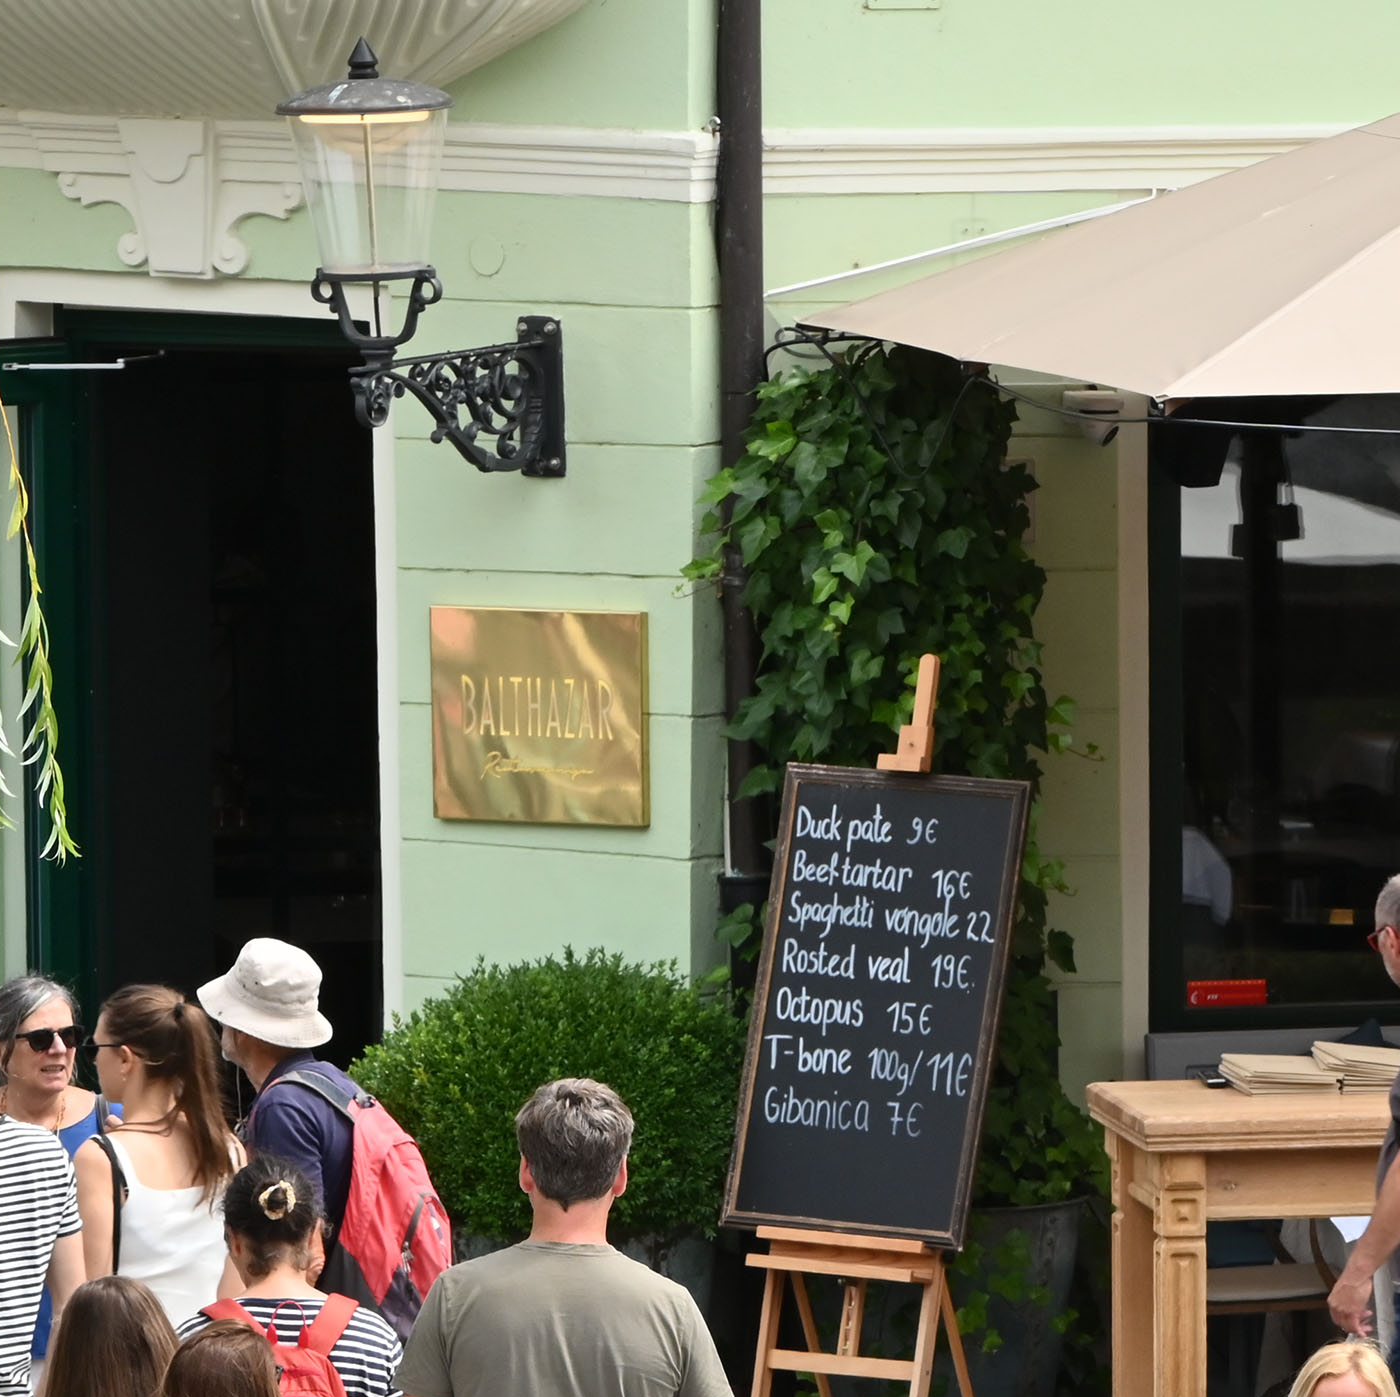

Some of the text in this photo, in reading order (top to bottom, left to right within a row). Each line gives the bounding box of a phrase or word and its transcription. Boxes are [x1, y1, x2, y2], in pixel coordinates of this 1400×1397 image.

[460, 673, 614, 741] BALTHAZAR
[796, 803, 939, 853] Duck pate 9€
[931, 870, 973, 901] 16€
[788, 893, 995, 949] Spaghetti vongole 22
[782, 938, 856, 980] Rosted
[867, 946, 911, 985] veal
[776, 987, 933, 1037] Octopus 15€
[763, 1033, 853, 1075] T-bone
[764, 1086, 925, 1138] Gibanica 7€
